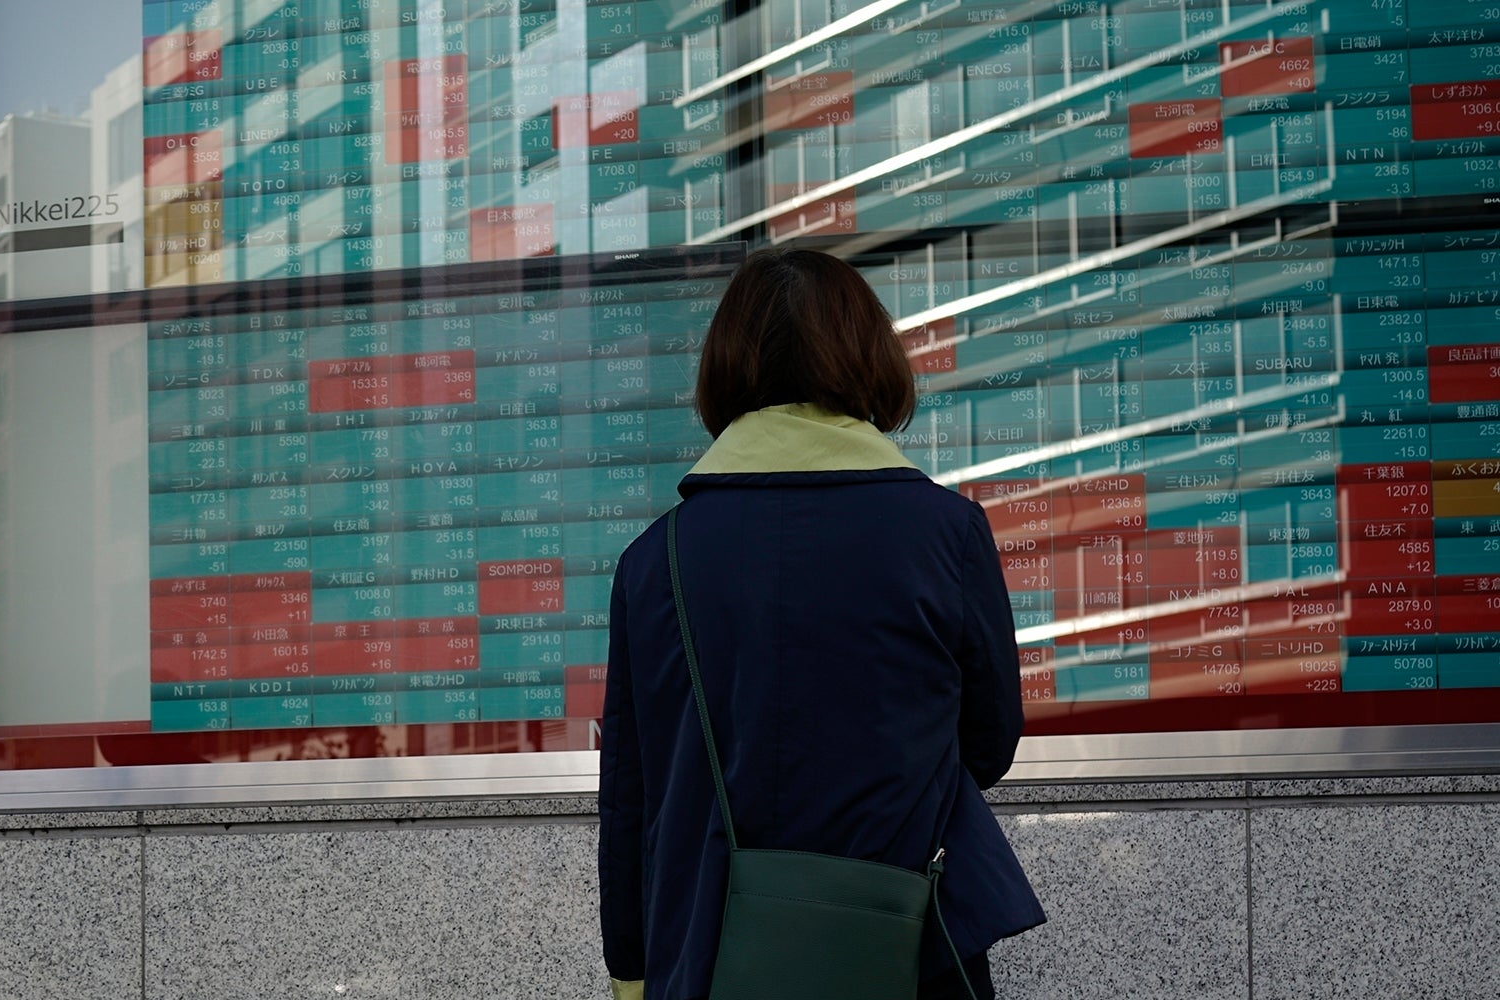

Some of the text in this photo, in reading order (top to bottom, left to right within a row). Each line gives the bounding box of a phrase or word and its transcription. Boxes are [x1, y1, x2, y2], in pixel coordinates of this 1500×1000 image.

[1374, 53, 1403, 65] 3421
[1376, 108, 1406, 120] 5194
[1375, 164, 1409, 177] 236.5
[1378, 256, 1419, 269] 1471.5
[1389, 275, 1420, 286] -32.0
[603, 306, 642, 319] 2414.0
[528, 313, 555, 324] 3945
[1380, 313, 1422, 325] 2382.0
[443, 319, 470, 330] 8343
[613, 325, 642, 335] -36.0
[278, 331, 304, 342] 3747
[350, 326, 387, 337] 2535.5
[1391, 331, 1422, 343] -13.0
[188, 336, 224, 350] 2448.5
[607, 361, 643, 373] 64950
[1256, 357, 1312, 370] SUBARU
[444, 372, 471, 383] 3369
[528, 367, 556, 378] 8134
[1383, 371, 1424, 382] 1300.5
[352, 378, 387, 389] 1533.5
[198, 389, 224, 400] 3023
[270, 384, 305, 395] 1904.0
[1393, 389, 1424, 401] -14.0
[526, 420, 557, 431] 363.8
[606, 414, 643, 426] 1990.5
[362, 431, 388, 441] 7749
[441, 425, 472, 437] 877.0
[1383, 427, 1426, 439] 2261.0
[279, 436, 306, 446] 5590
[529, 437, 556, 447] -10.1
[615, 432, 644, 442] -44.5
[189, 441, 224, 453] 2206.5
[1395, 446, 1426, 458] -15.0
[198, 459, 224, 469] -22.5
[530, 473, 557, 484] 4871
[607, 468, 644, 480] 1653.5
[362, 483, 388, 494] 9193
[439, 478, 472, 490] 19330
[270, 488, 306, 499] 2354.5
[1301, 489, 1332, 500] 3643
[1386, 485, 1428, 497] 1207.0
[190, 493, 224, 504] 1773.5
[449, 496, 473, 506] -165
[1101, 497, 1141, 508] 1236.5
[1205, 493, 1236, 504] 3679
[1007, 501, 1047, 514] 1775.0
[1402, 503, 1428, 515] +7.0
[1116, 515, 1141, 526] +8.0
[522, 527, 559, 538] 1199.5
[607, 523, 645, 534] 2421.0
[363, 536, 389, 547] 3197
[436, 531, 474, 543] 2516.5
[200, 546, 225, 556] 3133
[274, 541, 307, 552] 23150
[538, 545, 559, 555] -8.5
[1291, 546, 1333, 558] 2589.0
[1399, 542, 1430, 553] 4585
[445, 550, 474, 560] -31.5
[489, 563, 552, 576] SOMPOHD
[1211, 568, 1238, 579] +8.0
[532, 580, 559, 591] 3959
[1022, 575, 1048, 587] +7.0
[355, 589, 390, 601] 1008.0
[444, 584, 474, 596] 894.3
[200, 598, 226, 608] 3740
[281, 593, 307, 604] 3346
[370, 607, 390, 616] -6.0
[453, 603, 474, 613] -8.5
[1388, 600, 1431, 612] 2879.0
[1208, 607, 1239, 617] 7742
[1405, 619, 1432, 630] +3.0
[447, 638, 474, 648] 4581
[522, 635, 560, 646] 2914.0
[273, 647, 308, 657] 1601.5
[364, 643, 391, 653] 3979
[192, 649, 227, 660] 1742.5
[539, 652, 560, 663] -6.0
[285, 664, 308, 673] +0.5
[1299, 660, 1336, 672] 19025
[1394, 657, 1433, 670] 50780
[204, 666, 227, 676] +1.5
[1114, 667, 1144, 678] 5181
[1202, 664, 1240, 675] 14705
[1306, 680, 1336, 690] +225
[1406, 676, 1433, 688] -320
[445, 692, 475, 703] 535.4
[524, 689, 561, 700] 1589.5
[282, 699, 308, 709] 4924
[362, 695, 391, 706] 192.0
[198, 702, 227, 712] 153.8
[540, 706, 561, 716] -5.0
[207, 718, 227, 729] -0.7
